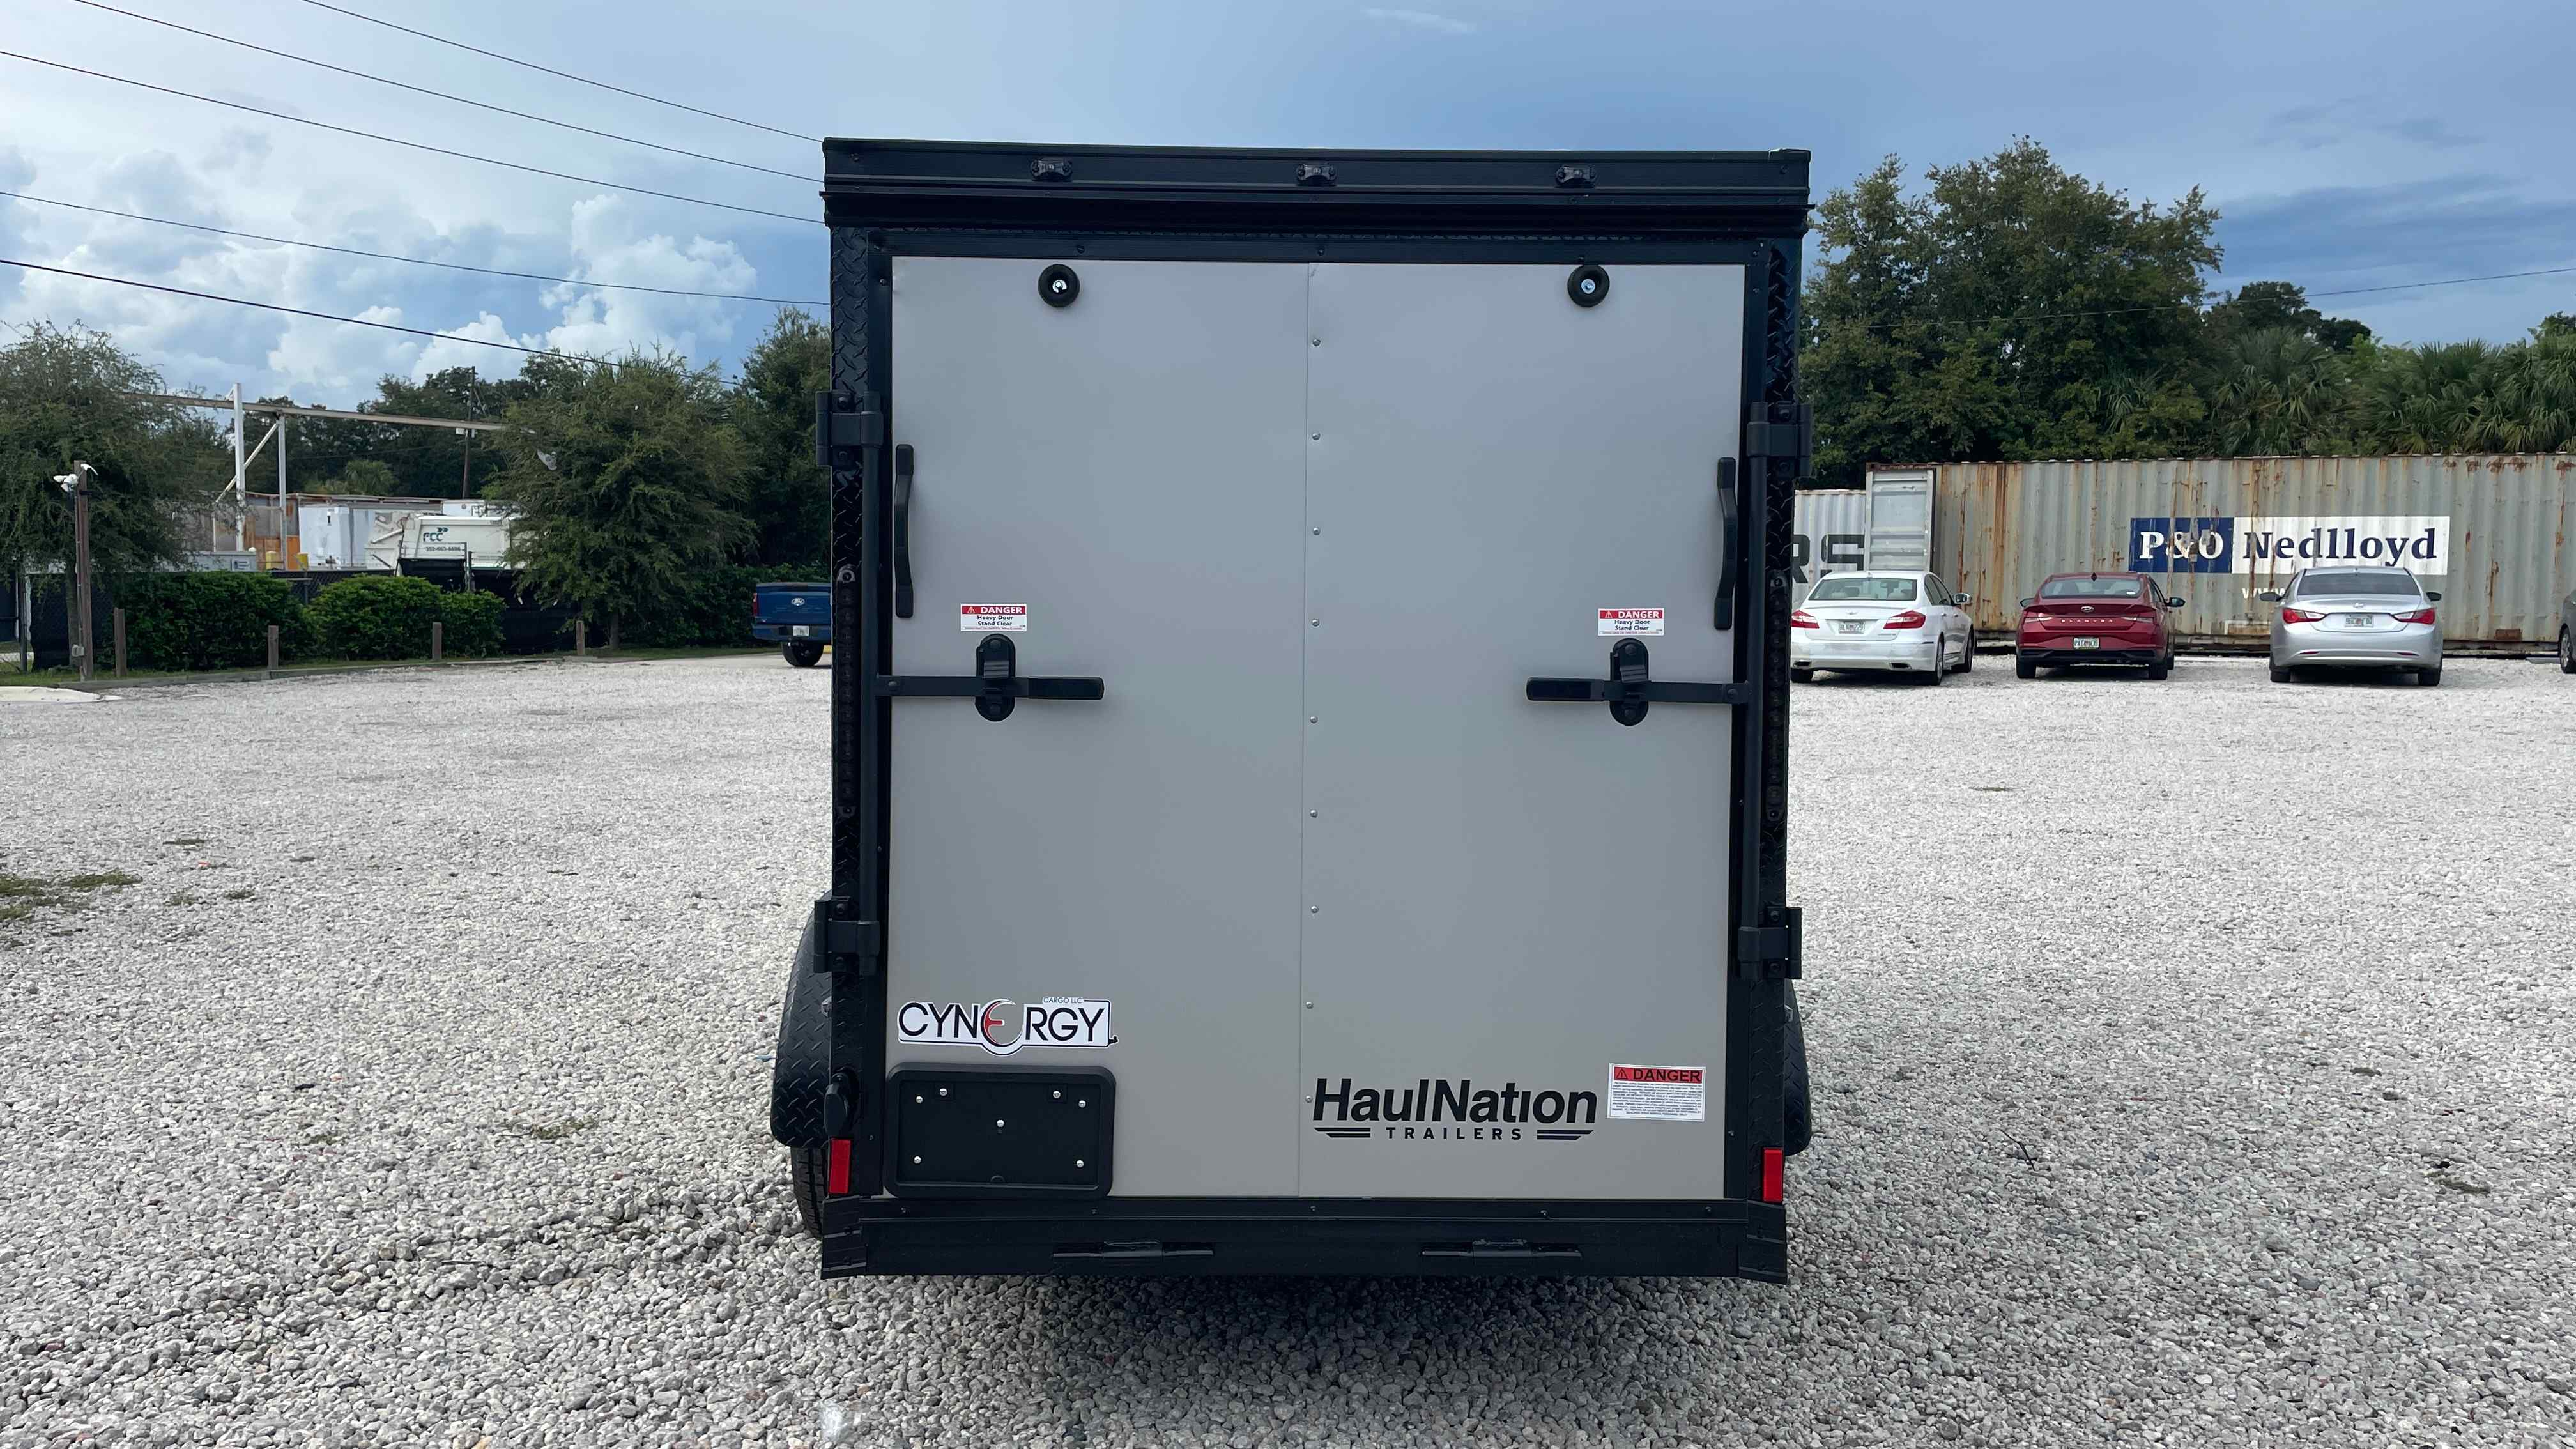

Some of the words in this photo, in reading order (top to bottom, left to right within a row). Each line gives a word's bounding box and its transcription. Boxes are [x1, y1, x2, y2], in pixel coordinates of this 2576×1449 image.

[423, 532, 443, 542] FCC
[2138, 531, 2224, 560] P&O
[2243, 528, 2437, 567] Nedlloyd
[898, 999, 1105, 1048] CYNERGY
[1633, 1068, 1700, 1082] DANGER
[1313, 1078, 1597, 1123] HaulNation
[1386, 1127, 1521, 1140] TRAILERS
